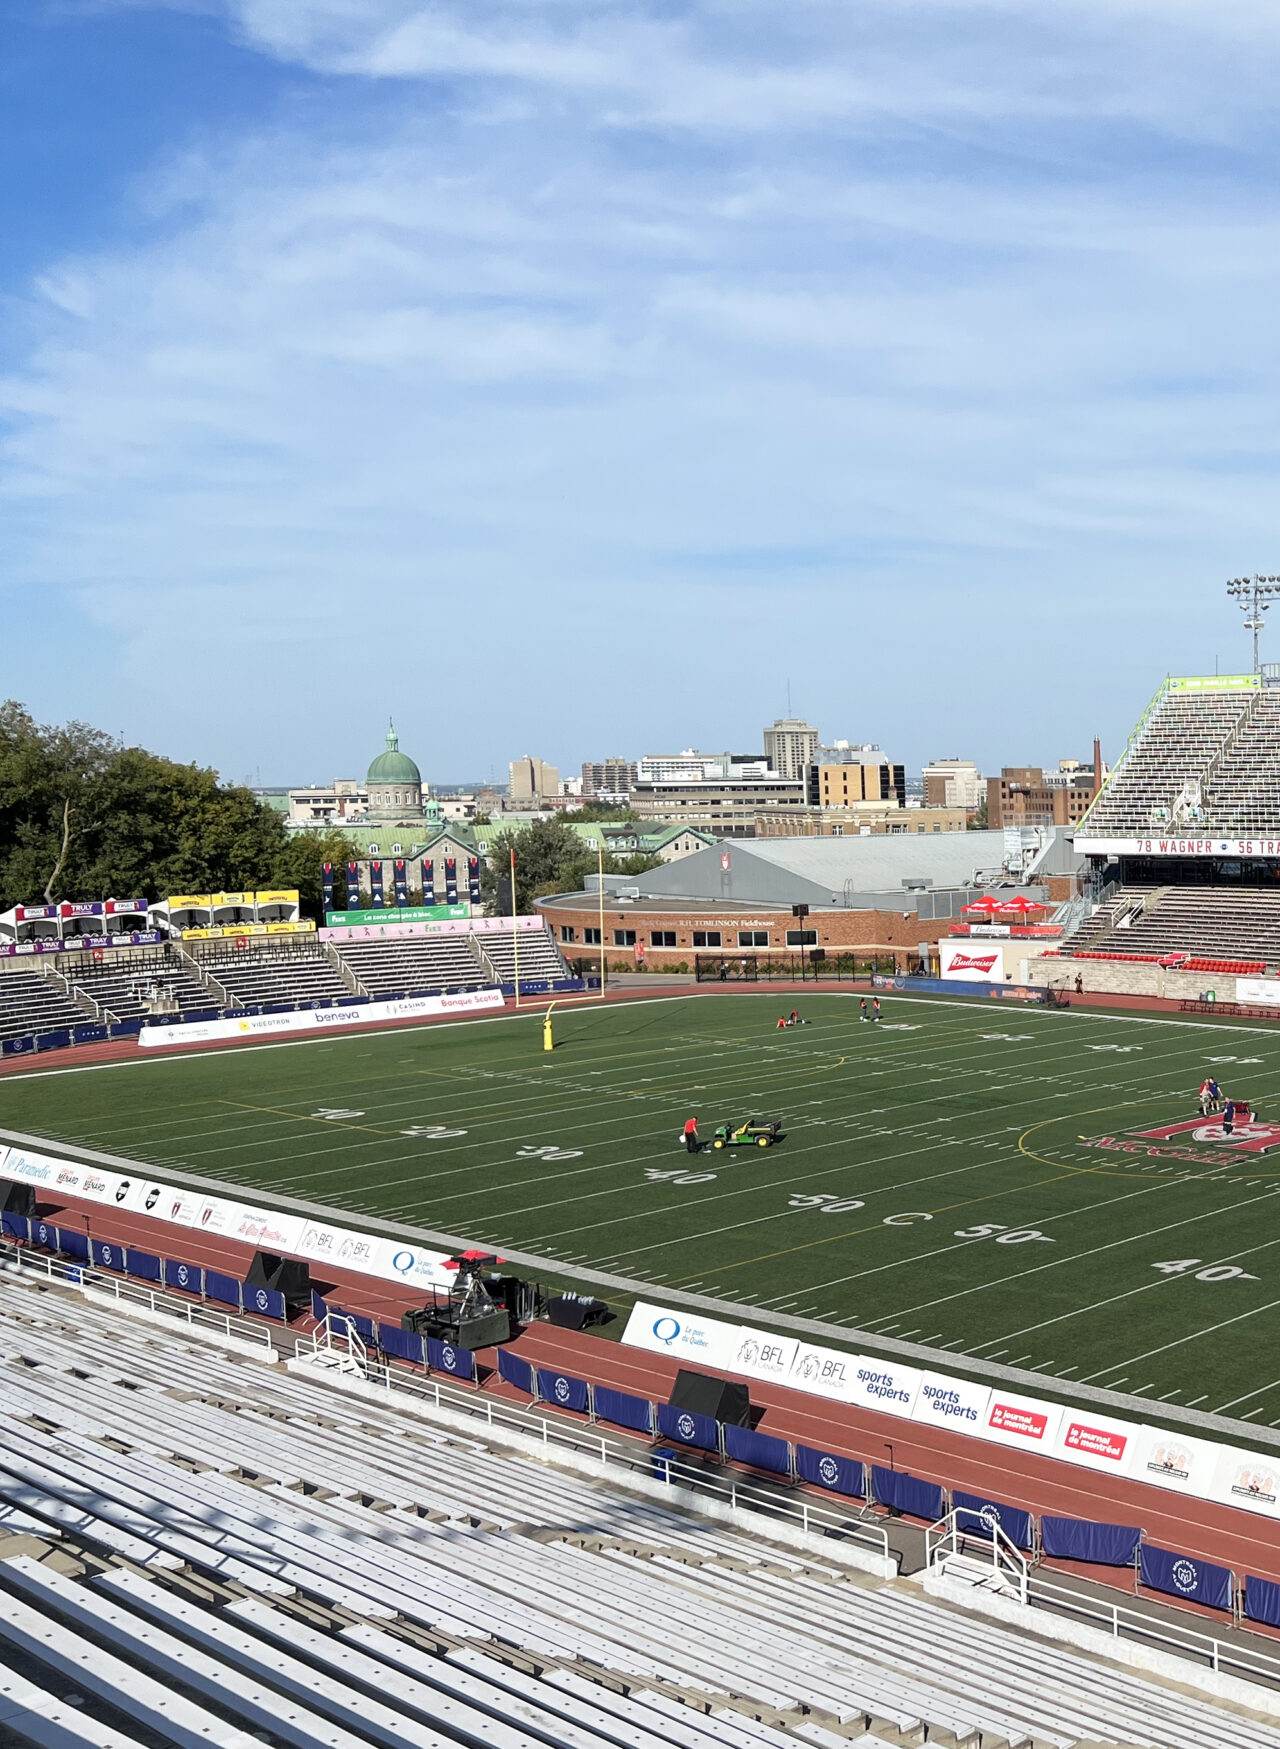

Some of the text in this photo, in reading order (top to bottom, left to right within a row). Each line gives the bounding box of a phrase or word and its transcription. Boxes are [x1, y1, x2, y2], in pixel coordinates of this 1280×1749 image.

[1137, 840, 1212, 853] 78 WAGNER
[1238, 841, 1253, 854] 56
[71, 904, 93, 912] TRULY
[741, 919, 775, 927] Fieldhouse
[952, 956, 995, 967] Budweiser
[399, 1002, 426, 1010] CASINO
[441, 994, 499, 1008] Banque Scotia
[252, 1018, 290, 1028] VIDEOTRON
[315, 1010, 360, 1022] beneva
[400, 1125, 468, 1139] 20
[516, 1145, 584, 1160] 30
[644, 1168, 717, 1184] 40
[788, 1194, 865, 1213] 50
[883, 1212, 934, 1226] C
[317, 1233, 334, 1249] BFL
[954, 1223, 1043, 1244] 50
[353, 1241, 371, 1258] BFL
[1151, 1259, 1244, 1281] 40
[652, 1317, 681, 1346] Q
[760, 1345, 785, 1366] BFL
[822, 1360, 847, 1381] BFL
[857, 1368, 894, 1387] sports
[866, 1382, 911, 1403] experts
[922, 1384, 960, 1404] sports
[932, 1399, 978, 1421] experts
[994, 1408, 1033, 1425] le journal
[992, 1416, 1042, 1435] de montréal
[1070, 1428, 1111, 1444] le journal
[1068, 1436, 1121, 1456] de montréal
[1172, 1559, 1198, 1579] MONTREAL
[1172, 1573, 1198, 1593] ALOUETTES
